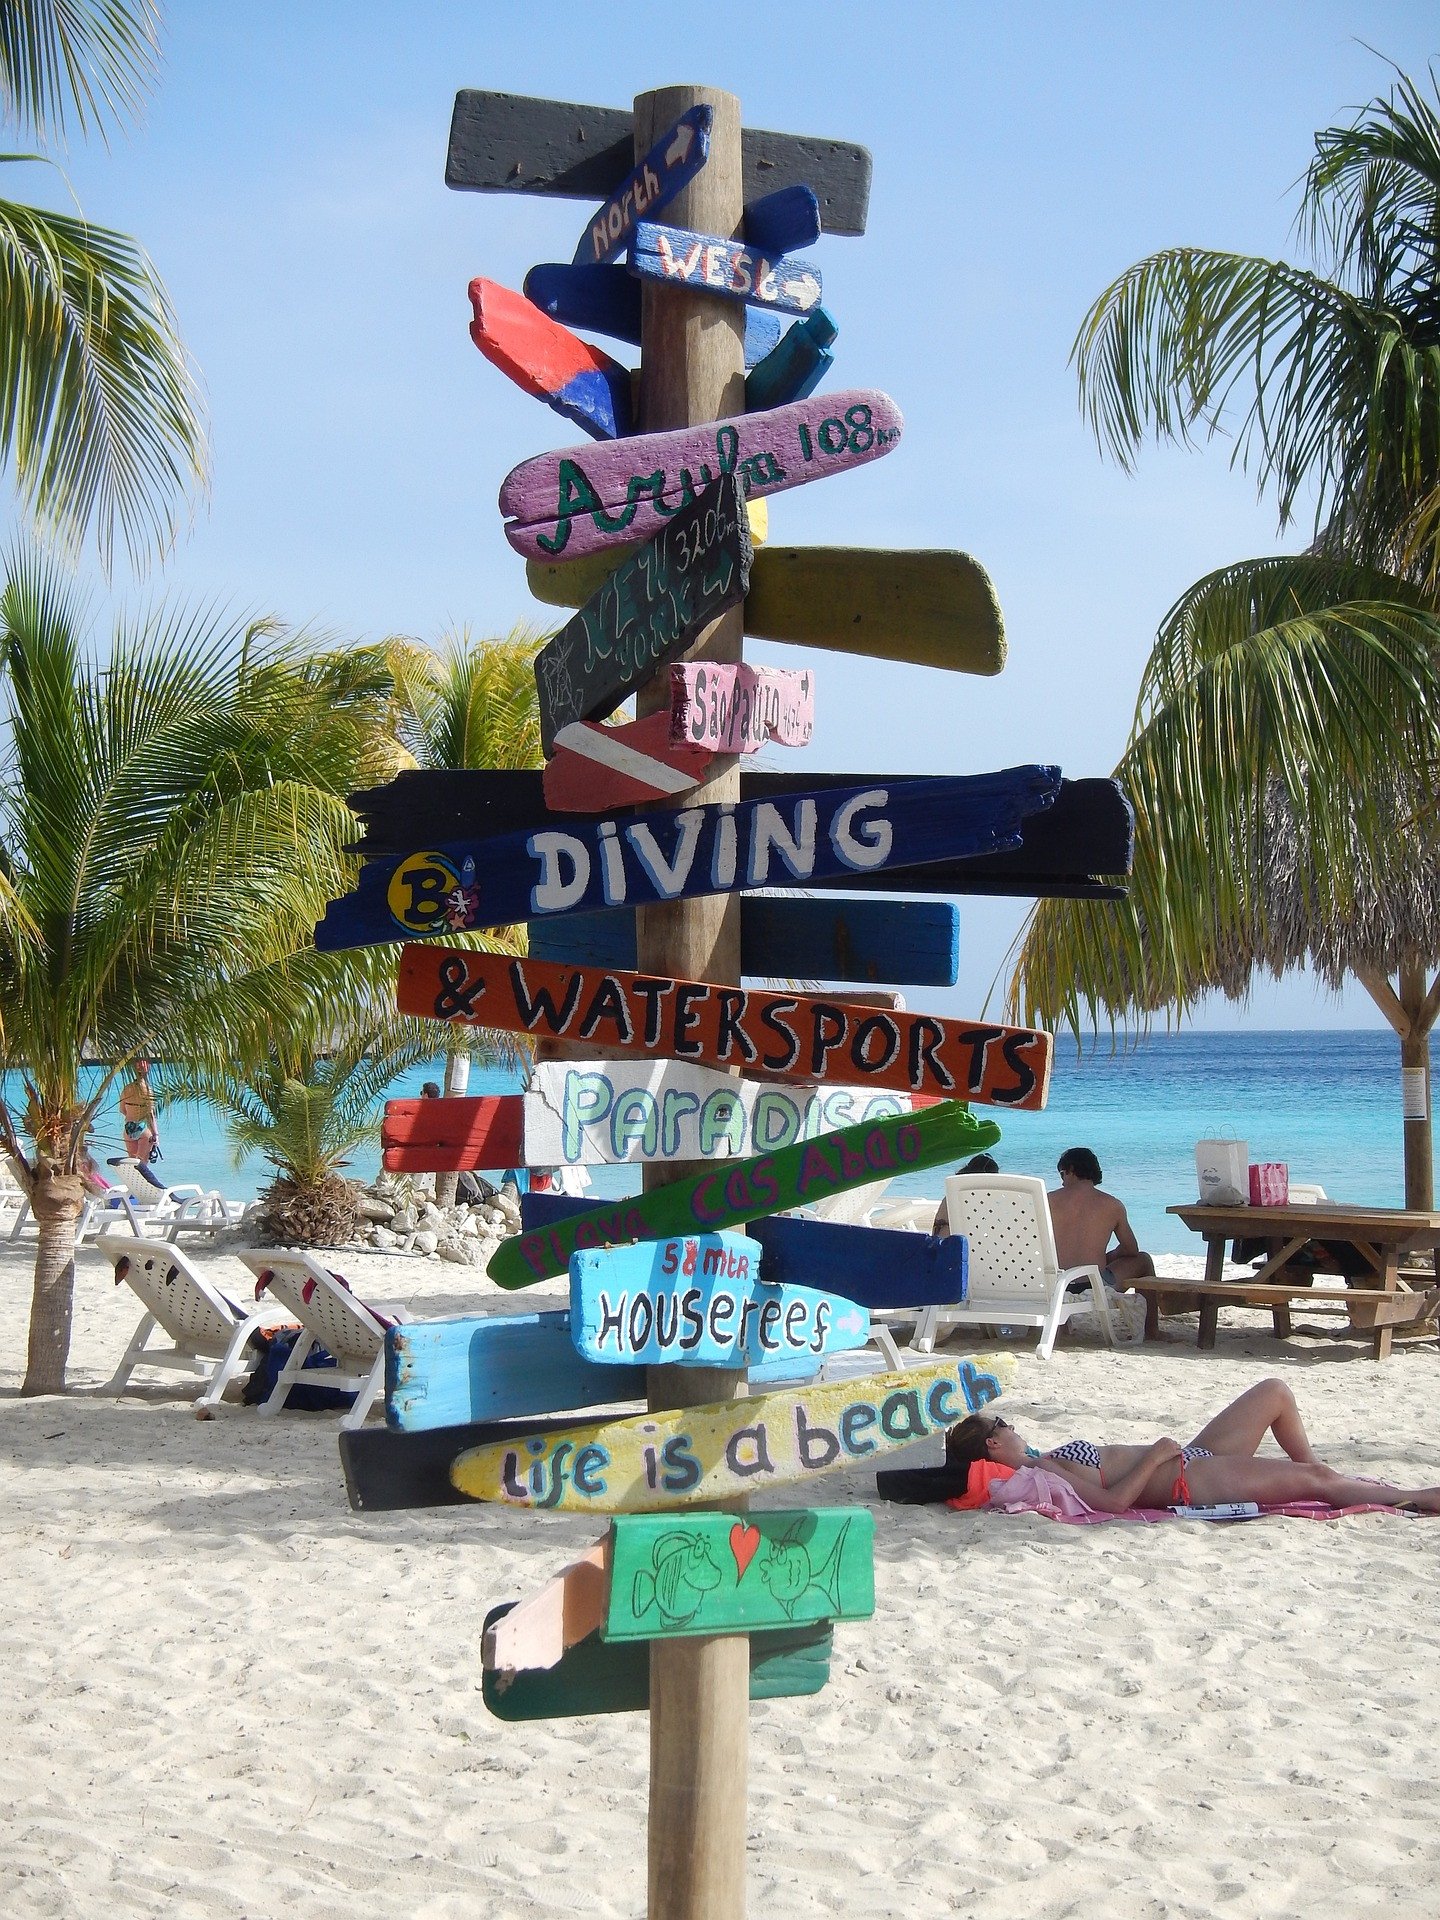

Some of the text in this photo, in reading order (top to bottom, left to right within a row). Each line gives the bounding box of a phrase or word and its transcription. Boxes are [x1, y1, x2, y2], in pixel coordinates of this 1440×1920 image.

[536, 426, 788, 555] Aruba
[434, 956, 1042, 1103] & WATERSPORTS
[643, 1424, 701, 1491] is
[725, 1423, 775, 1477] a
[793, 1360, 1001, 1470] beach
